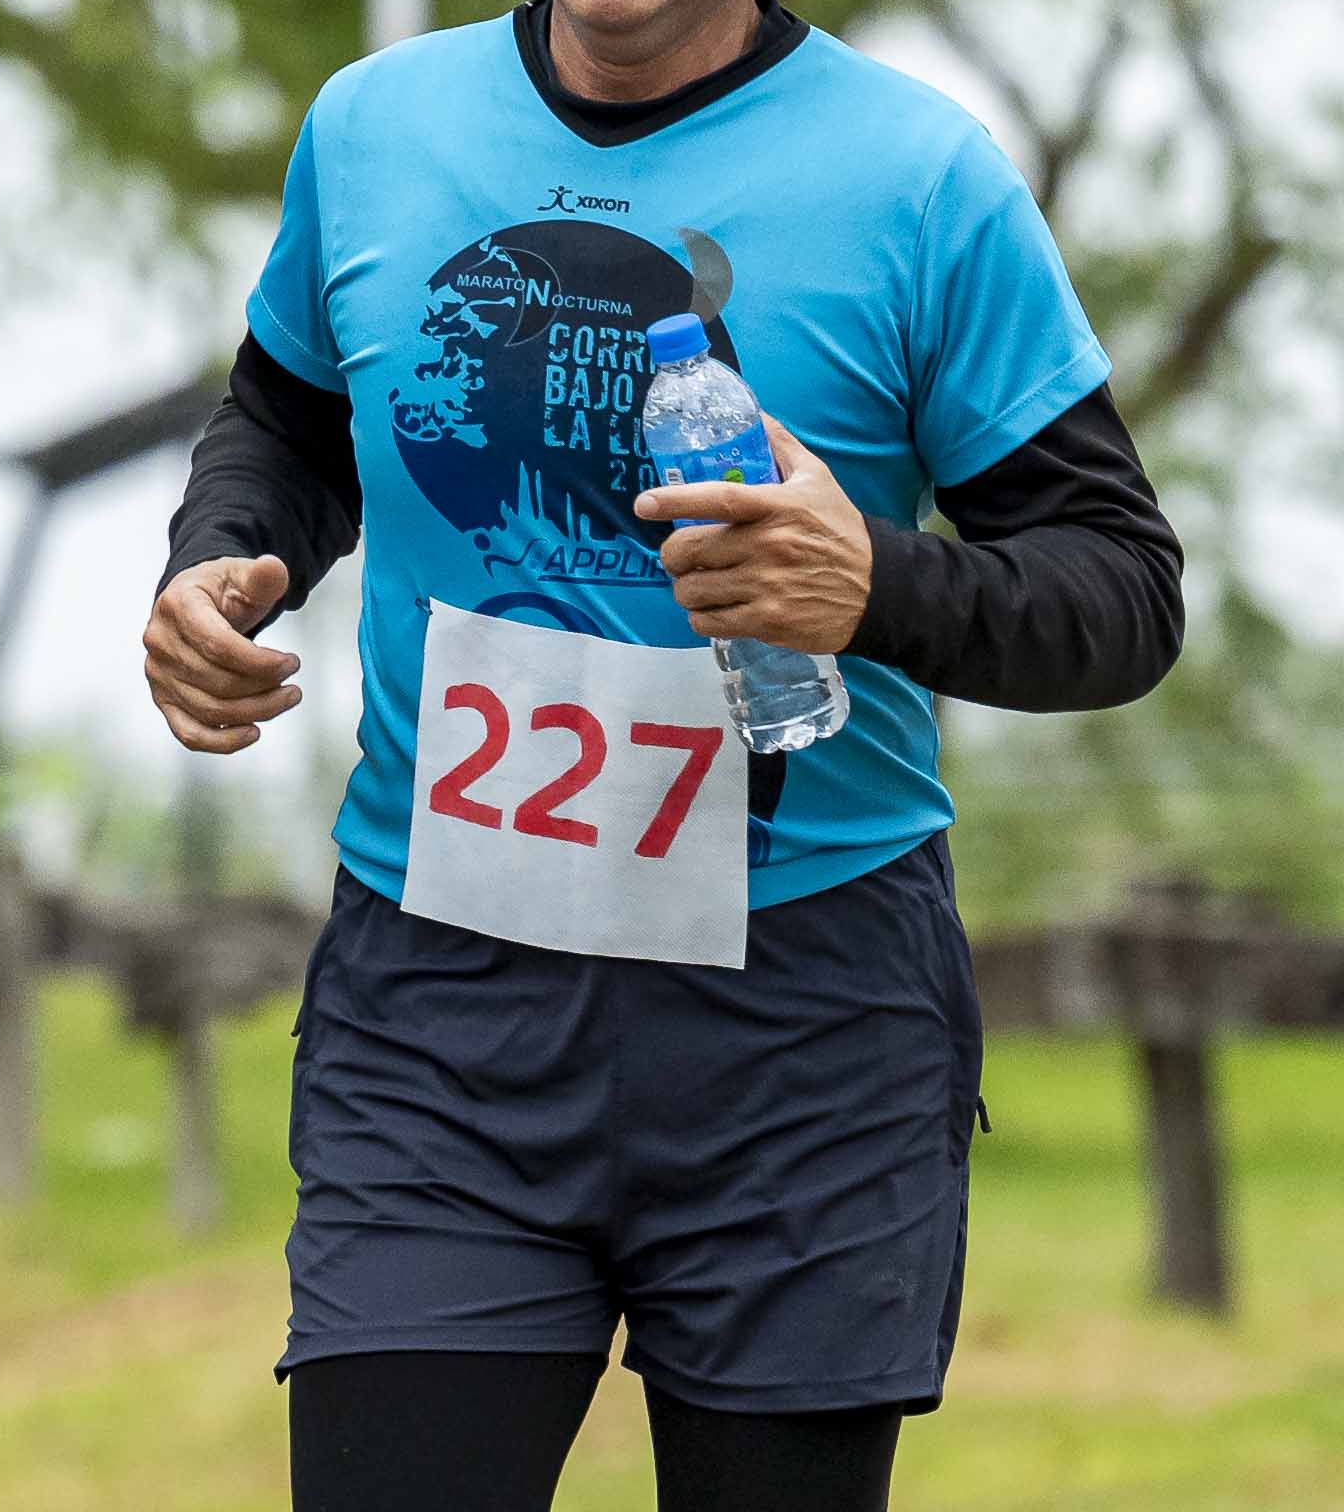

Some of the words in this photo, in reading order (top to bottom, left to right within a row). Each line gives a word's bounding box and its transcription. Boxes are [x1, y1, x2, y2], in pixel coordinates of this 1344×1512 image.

[548, 322, 656, 375] CORR
[544, 364, 634, 413] BAJO
[543, 407, 591, 451] LA
[429, 683, 724, 859] 227
